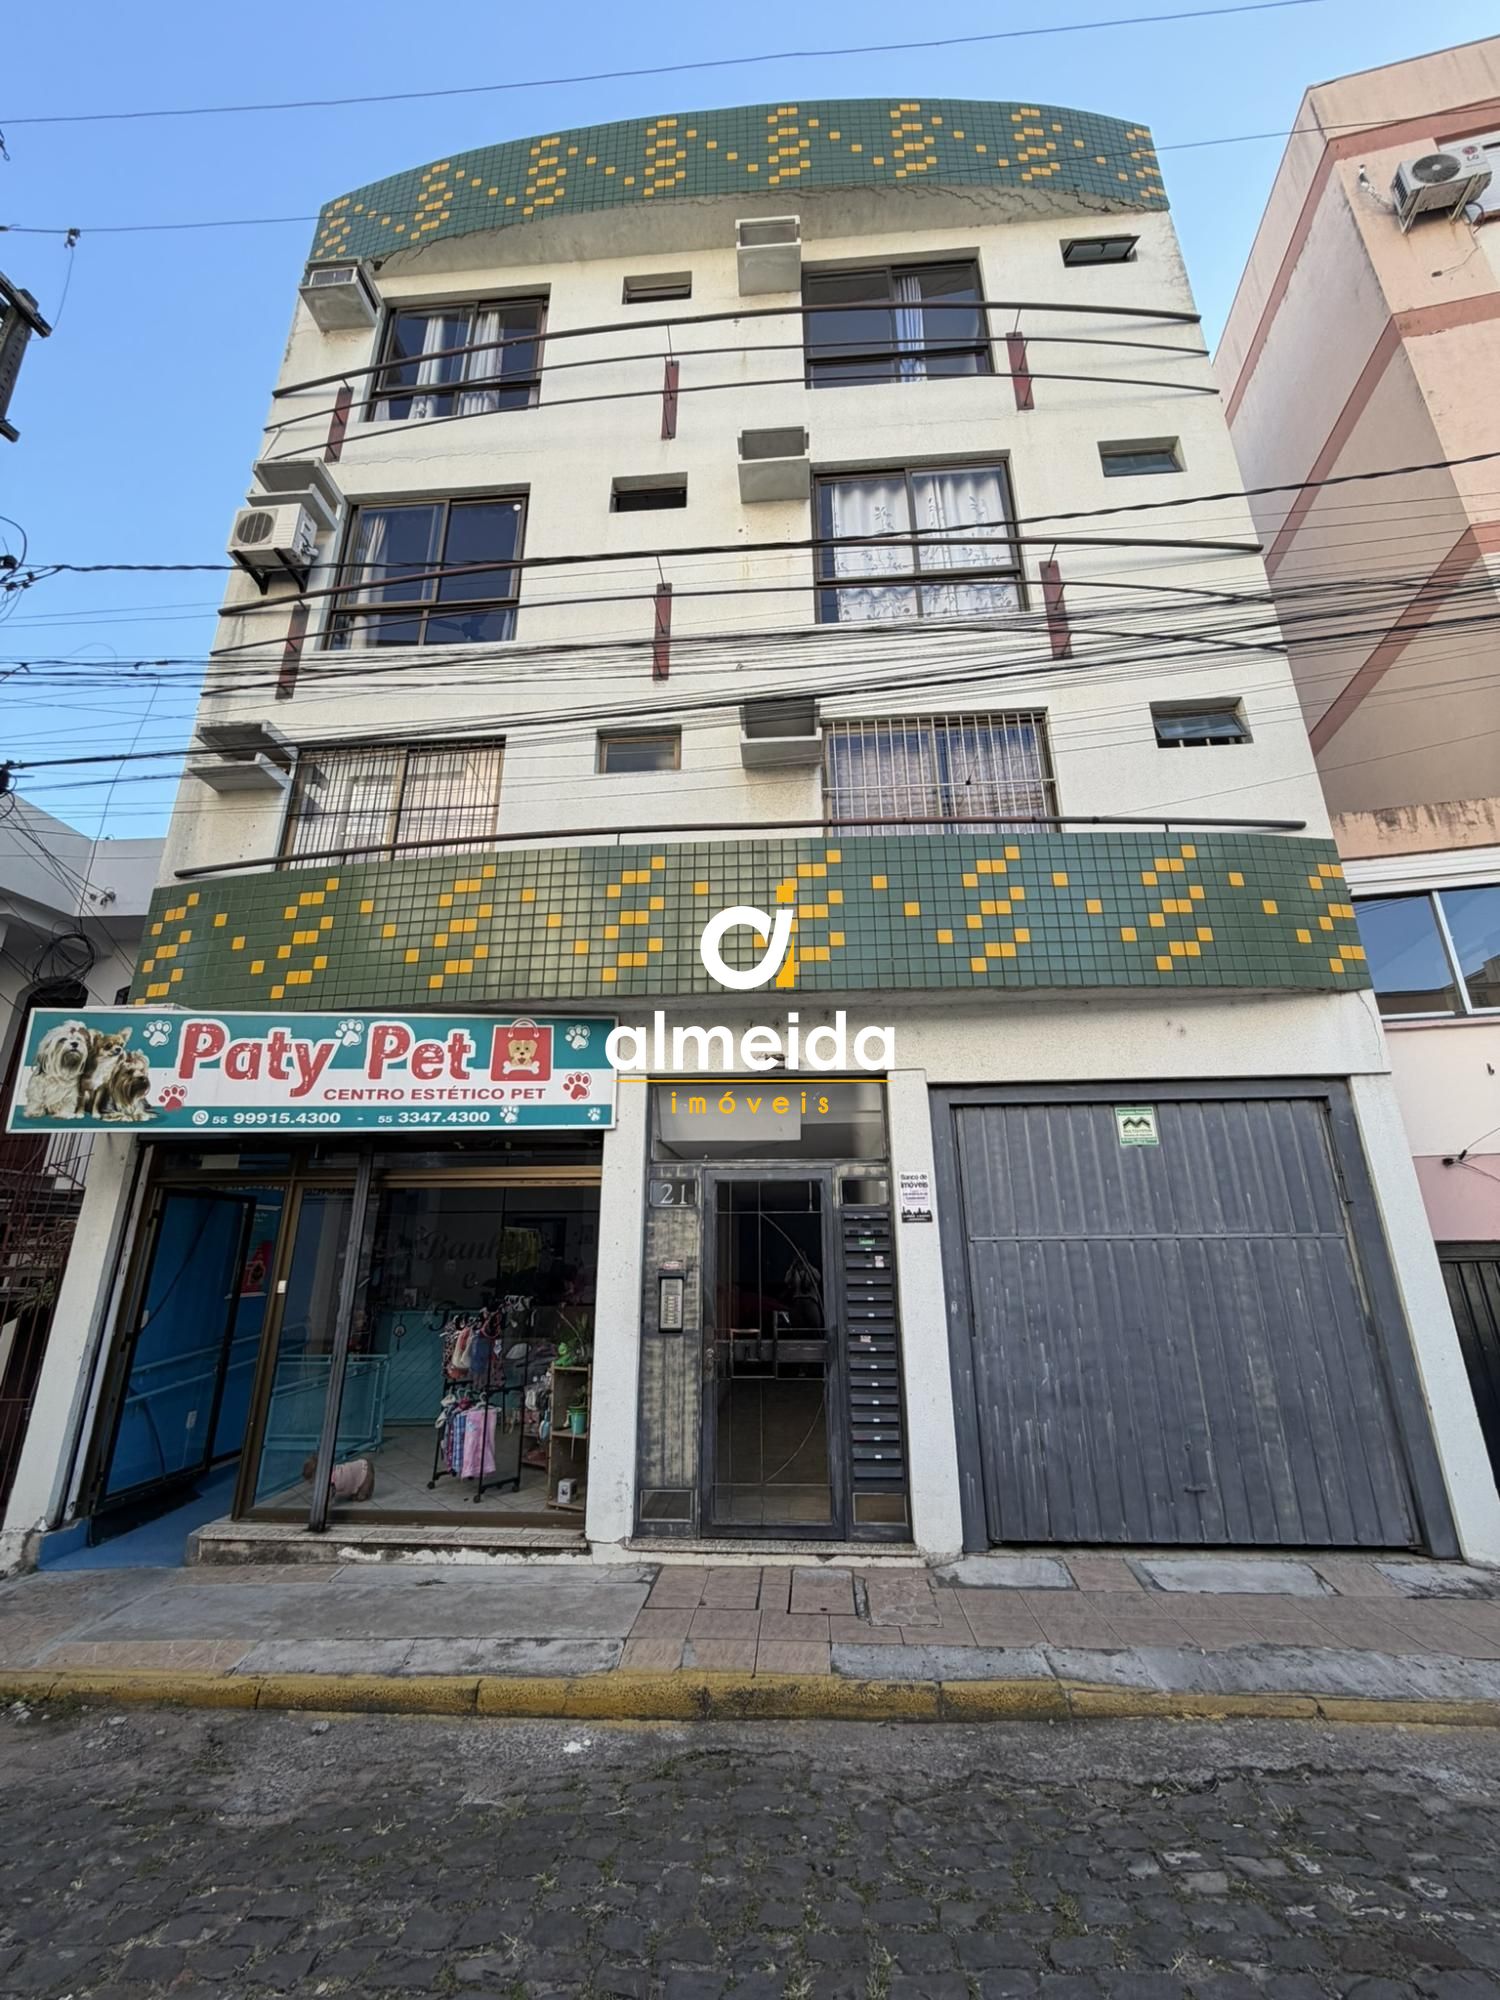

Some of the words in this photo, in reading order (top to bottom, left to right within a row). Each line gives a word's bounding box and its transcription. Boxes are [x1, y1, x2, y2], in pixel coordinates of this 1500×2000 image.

[177, 1021, 335, 1098] Paty
[367, 1024, 472, 1081] Pet
[323, 1087, 405, 1101] CENTRO
[410, 1085, 505, 1101] ESTÉTICO
[510, 1087, 547, 1100] PET
[212, 1115, 229, 1125] 55
[232, 1112, 342, 1125] 99915.4300
[377, 1114, 394, 1124] 55
[397, 1111, 491, 1124] 3347.4300
[660, 1183, 688, 1205] 21
